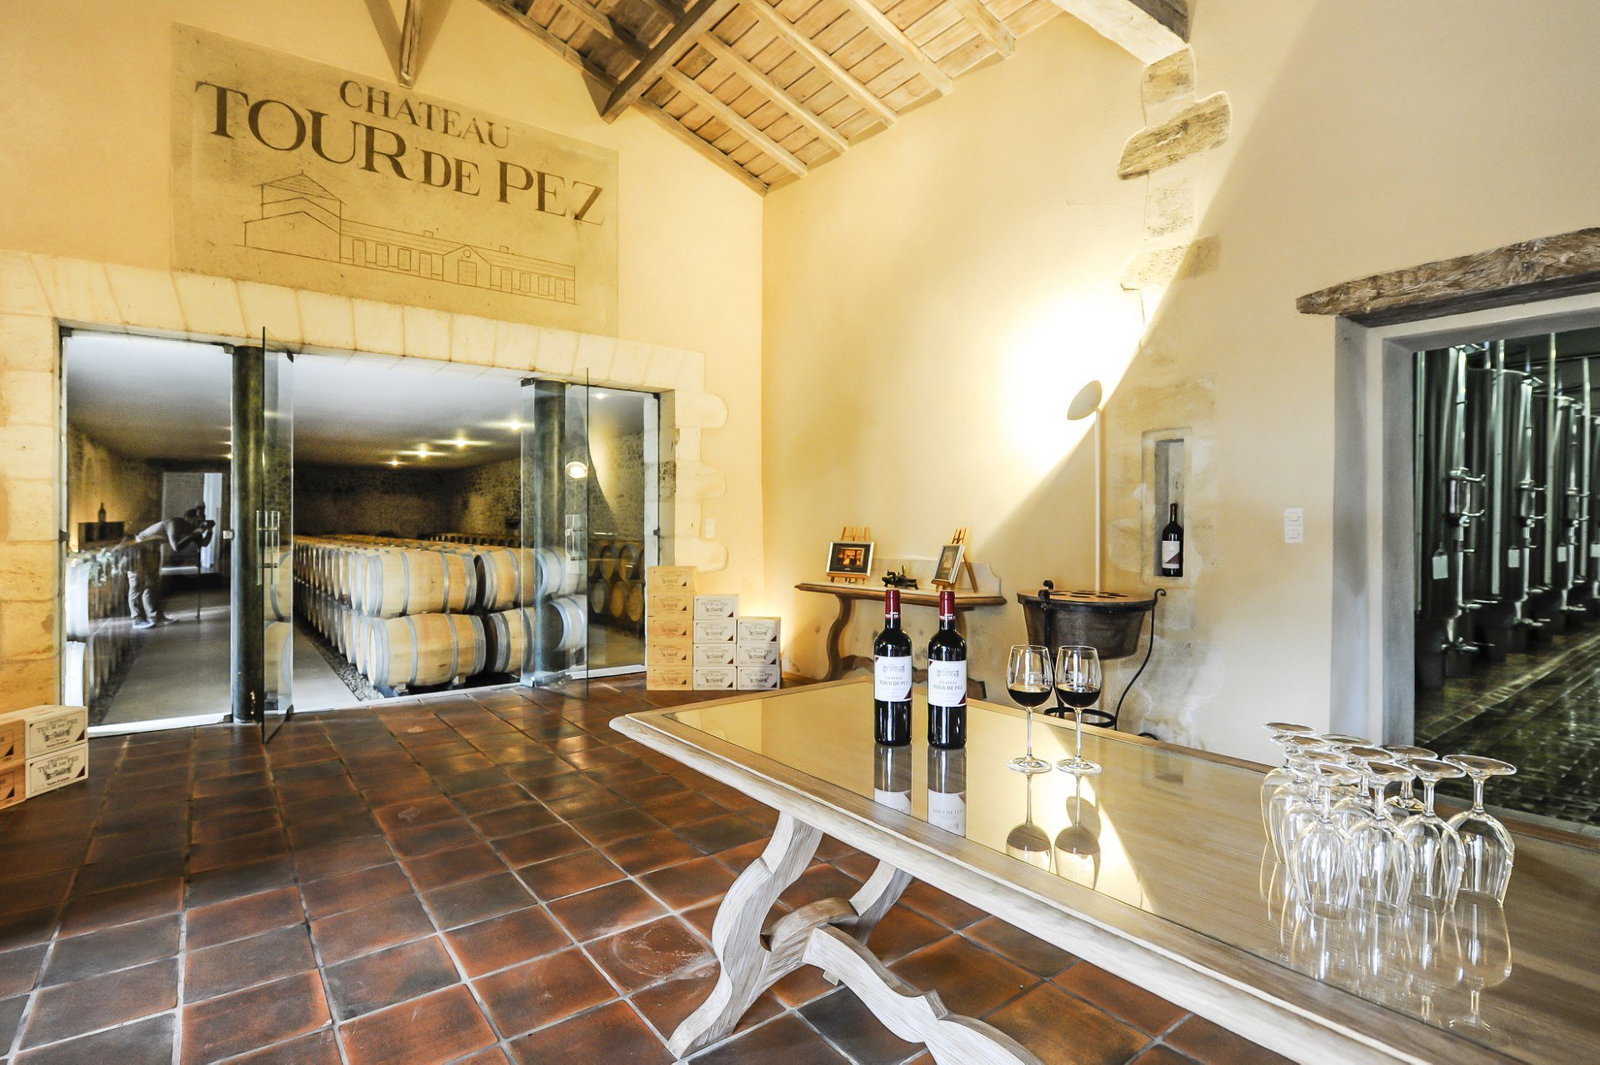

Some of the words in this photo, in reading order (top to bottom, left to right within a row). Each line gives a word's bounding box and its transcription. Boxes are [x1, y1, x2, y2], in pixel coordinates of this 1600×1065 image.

[195, 80, 413, 181] TOUR
[420, 149, 481, 197] DE
[496, 159, 606, 226] PEZ
[339, 79, 512, 149] CHATEAU
